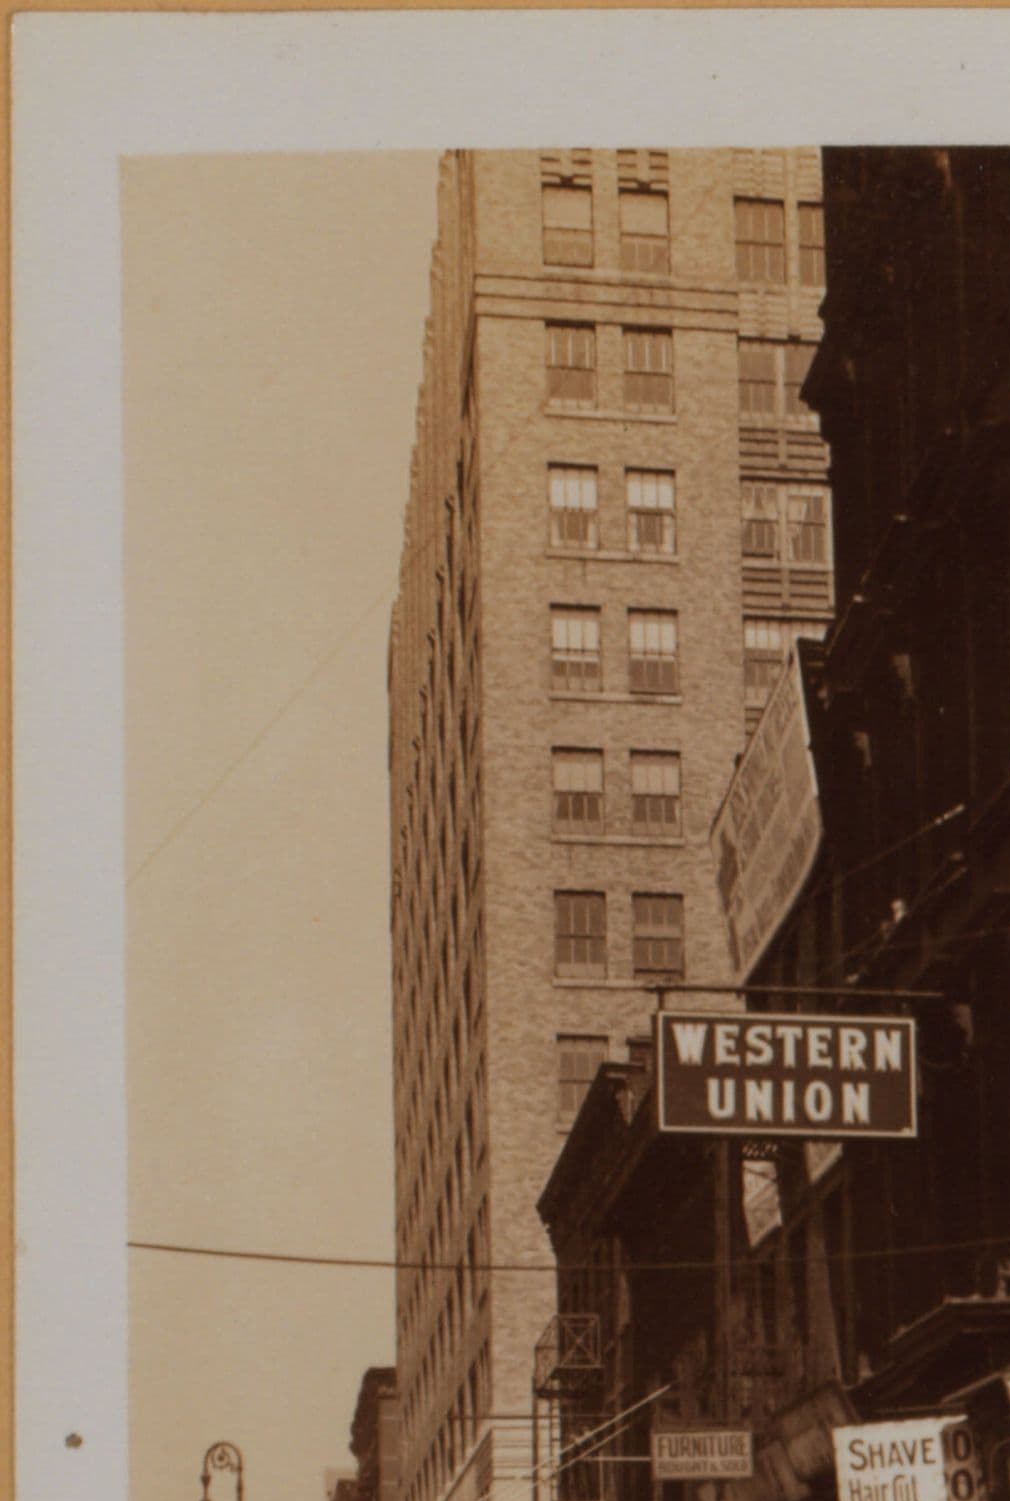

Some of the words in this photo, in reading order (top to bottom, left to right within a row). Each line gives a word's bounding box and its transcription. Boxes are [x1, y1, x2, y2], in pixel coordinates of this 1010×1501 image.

[672, 1022, 902, 1072] WESTERN
[707, 1077, 870, 1124] UNION
[657, 1435, 749, 1458] FURNITURE
[848, 1437, 937, 1471] SHAVE
